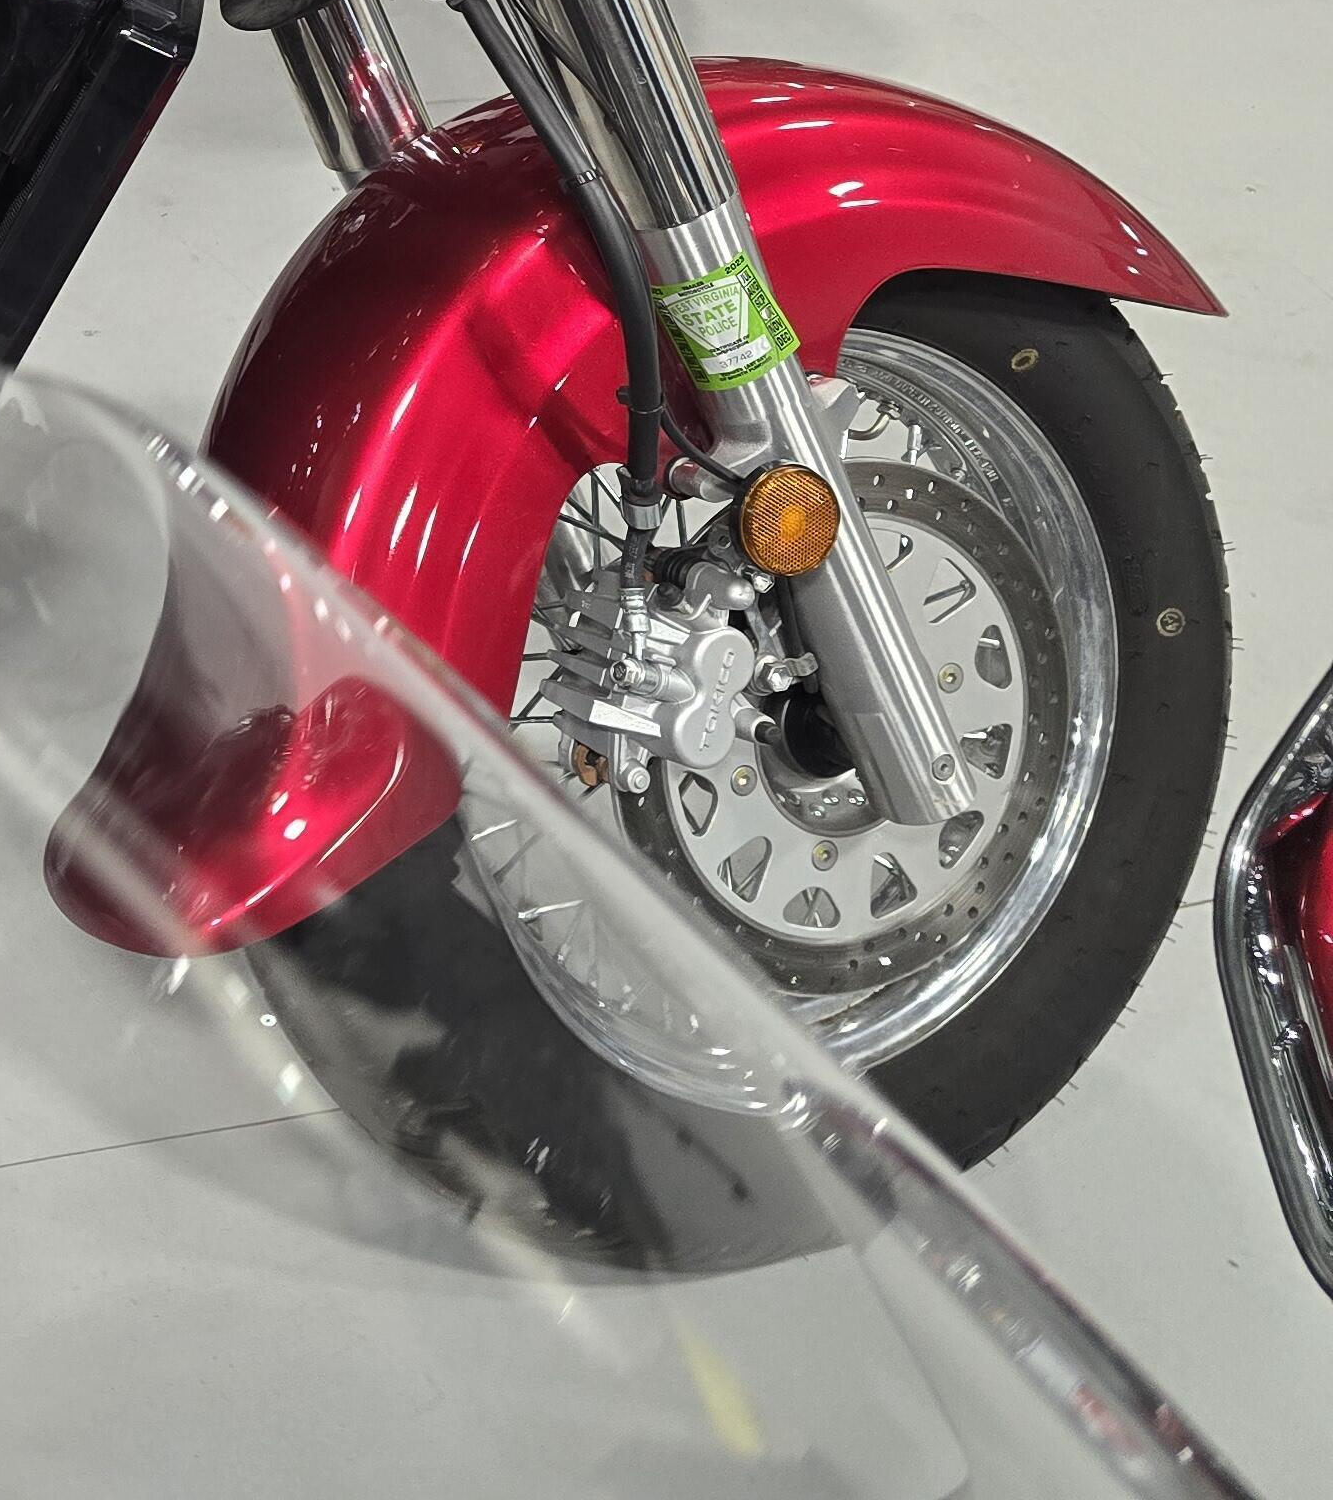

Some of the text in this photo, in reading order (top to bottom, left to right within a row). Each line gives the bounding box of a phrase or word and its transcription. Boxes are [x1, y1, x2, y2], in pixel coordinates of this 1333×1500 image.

[724, 255, 745, 275] 2023
[693, 285, 740, 308] VIRGINIA
[681, 300, 738, 327] STATE
[698, 317, 738, 337] POLICE
[776, 331, 792, 348] DEC
[719, 350, 754, 369] 37742
